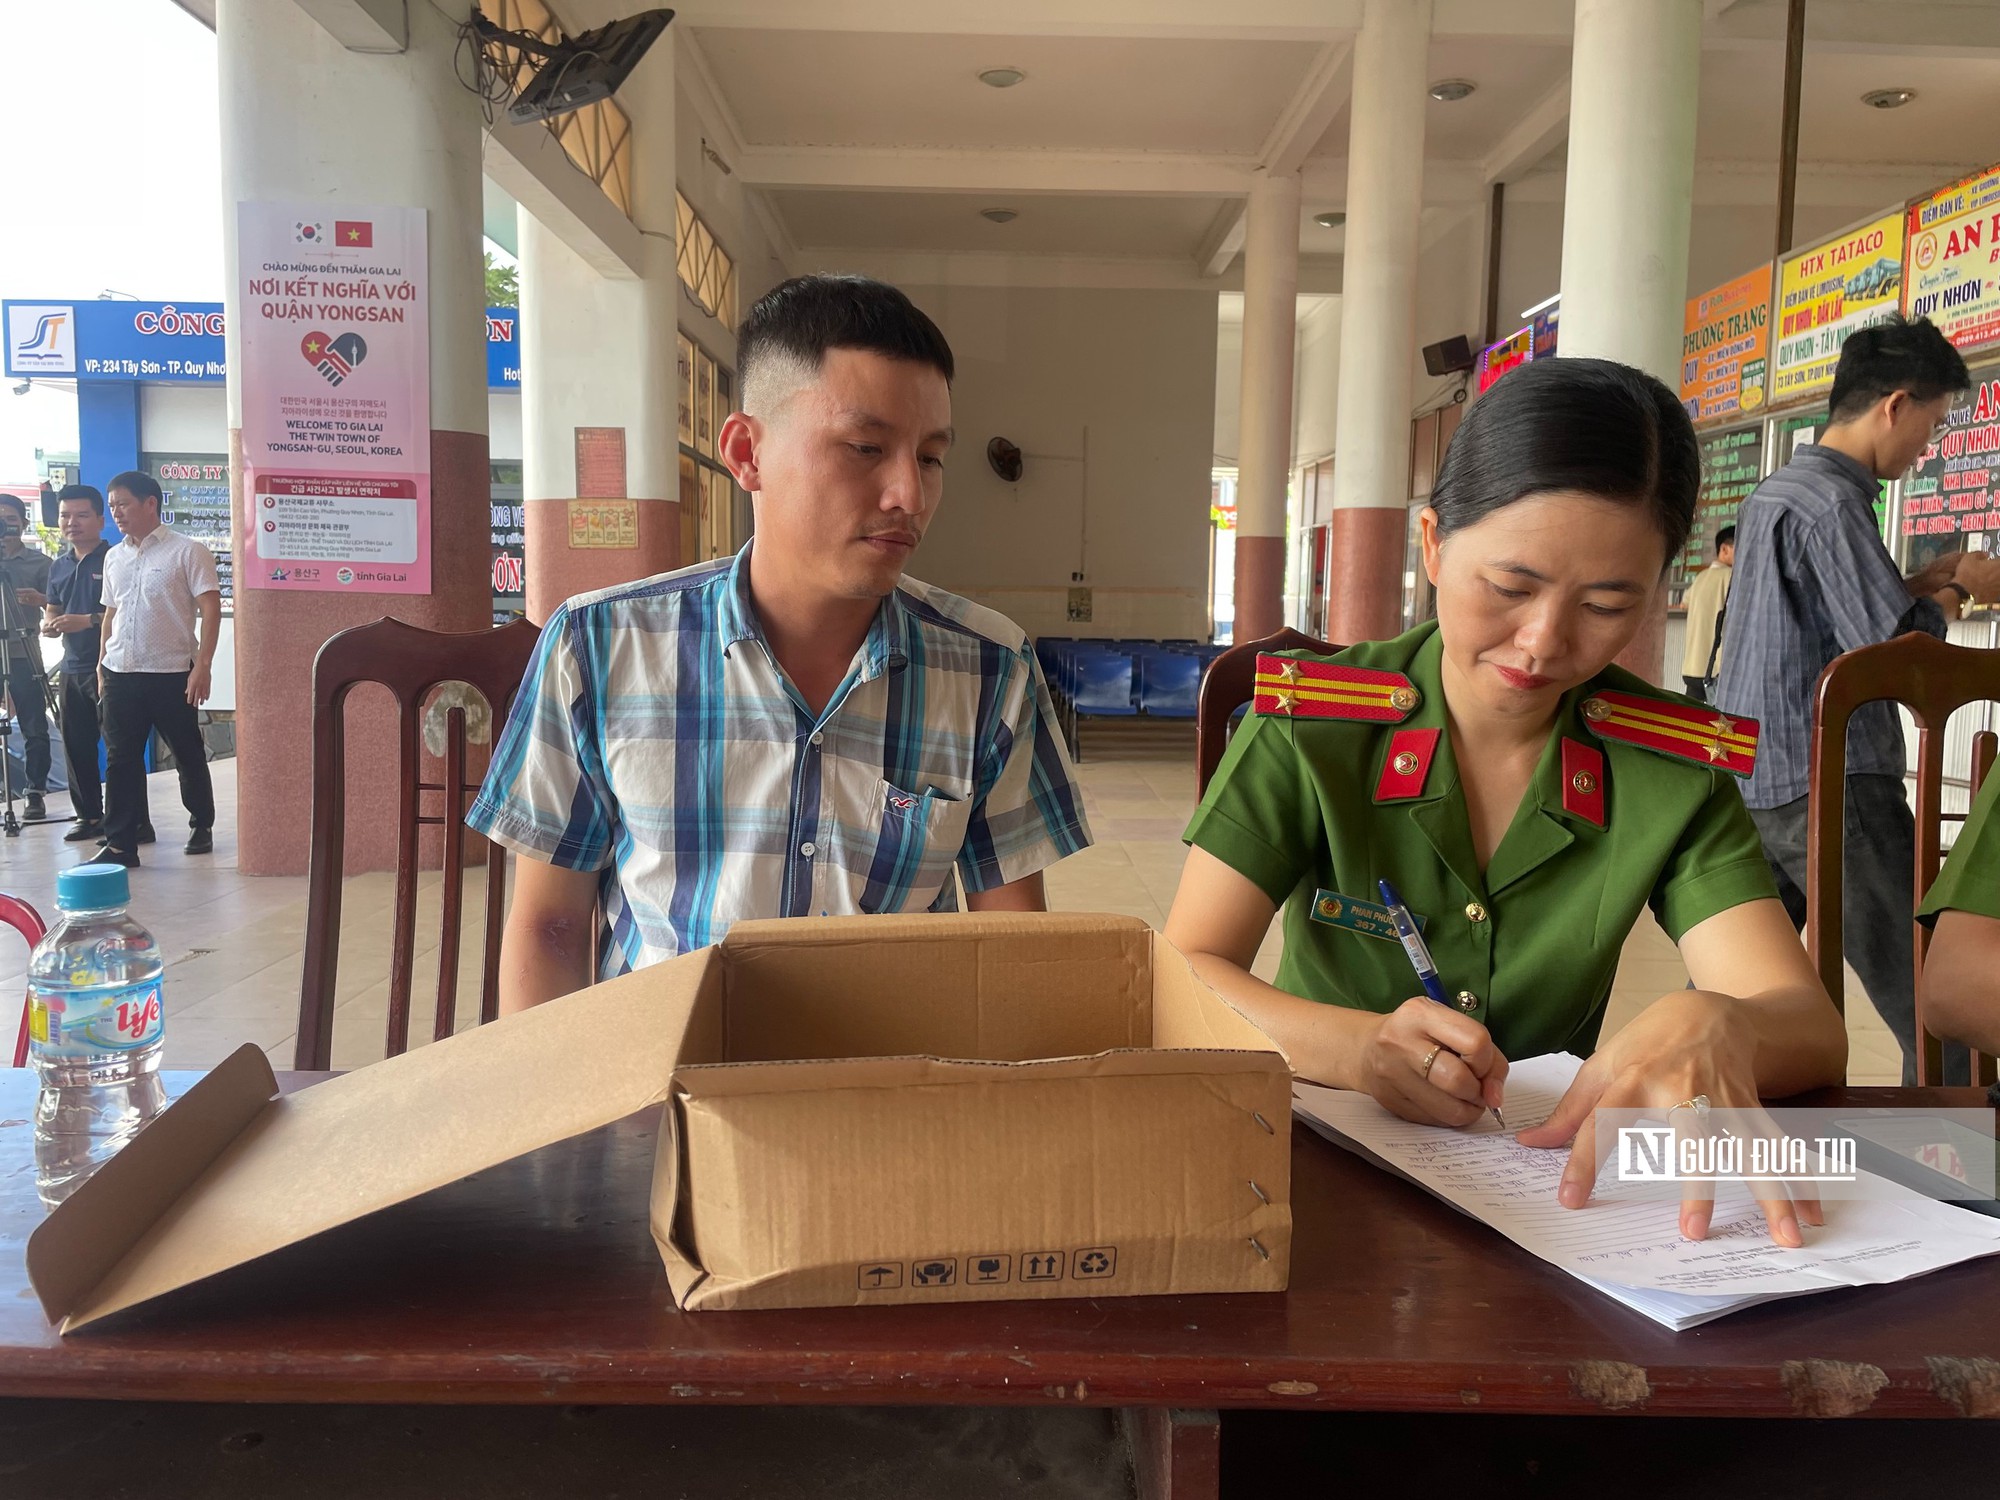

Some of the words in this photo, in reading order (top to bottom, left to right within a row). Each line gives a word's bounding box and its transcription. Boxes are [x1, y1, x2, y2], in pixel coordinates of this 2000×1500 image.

[1943, 219, 1983, 260] AN
[1801, 253, 1825, 278] HTX
[1830, 230, 1883, 267] TATACO
[369, 267, 384, 275] GIA
[386, 267, 401, 276] LAI
[249, 278, 280, 296] NƠI
[284, 275, 318, 297] KẾT
[323, 279, 380, 300] NGHĨA
[384, 281, 416, 301] VỚI
[1914, 292, 1939, 317] QUY
[1943, 279, 1981, 309] NHƠN
[135, 306, 225, 335] CÔNG
[261, 299, 313, 324] QUẬN
[317, 303, 404, 323] YONGSAN
[1683, 319, 1725, 357] PHƯƠNG
[1727, 304, 1767, 339] TRANG
[1779, 340, 1794, 366] QUY
[1795, 334, 1814, 362] NHƠN
[1820, 327, 1835, 354] TÂY
[85, 360, 101, 373] VP:
[103, 360, 120, 373] 234
[122, 360, 140, 376] Tây
[141, 360, 160, 374] Sơn
[167, 361, 183, 374] TP.
[185, 362, 205, 377] Quy
[206, 361, 226, 375] Nhơ
[1826, 361, 1837, 377] NHƠ
[286, 420, 333, 430] WELCOME
[335, 421, 348, 431] TO
[350, 422, 366, 431] GIA
[368, 423, 383, 432] LAI
[289, 432, 308, 441] THE
[309, 432, 335, 442] TWIN
[337, 433, 366, 443] TOWN
[367, 434, 380, 443] OF
[1941, 430, 1965, 460] QUY
[1966, 423, 2000, 455] NHƠN
[267, 443, 334, 455] YONGSAN-GU,
[335, 445, 369, 456] SEOUL,
[371, 447, 403, 456] KOREA
[161, 462, 200, 479] CÔNG
[203, 466, 223, 480] TY
[1943, 472, 1961, 491] NHA
[1962, 468, 1990, 489] TRANG
[491, 532, 506, 546] ing
[506, 532, 525, 544] offic
[294, 567, 321, 579] 용산구
[377, 572, 392, 582] Gia
[393, 572, 407, 582] Lai
[492, 552, 522, 592] ƠN
[1351, 905, 1373, 919] PHAN
[1354, 919, 1376, 931] 367
[116, 989, 160, 1038] Life
